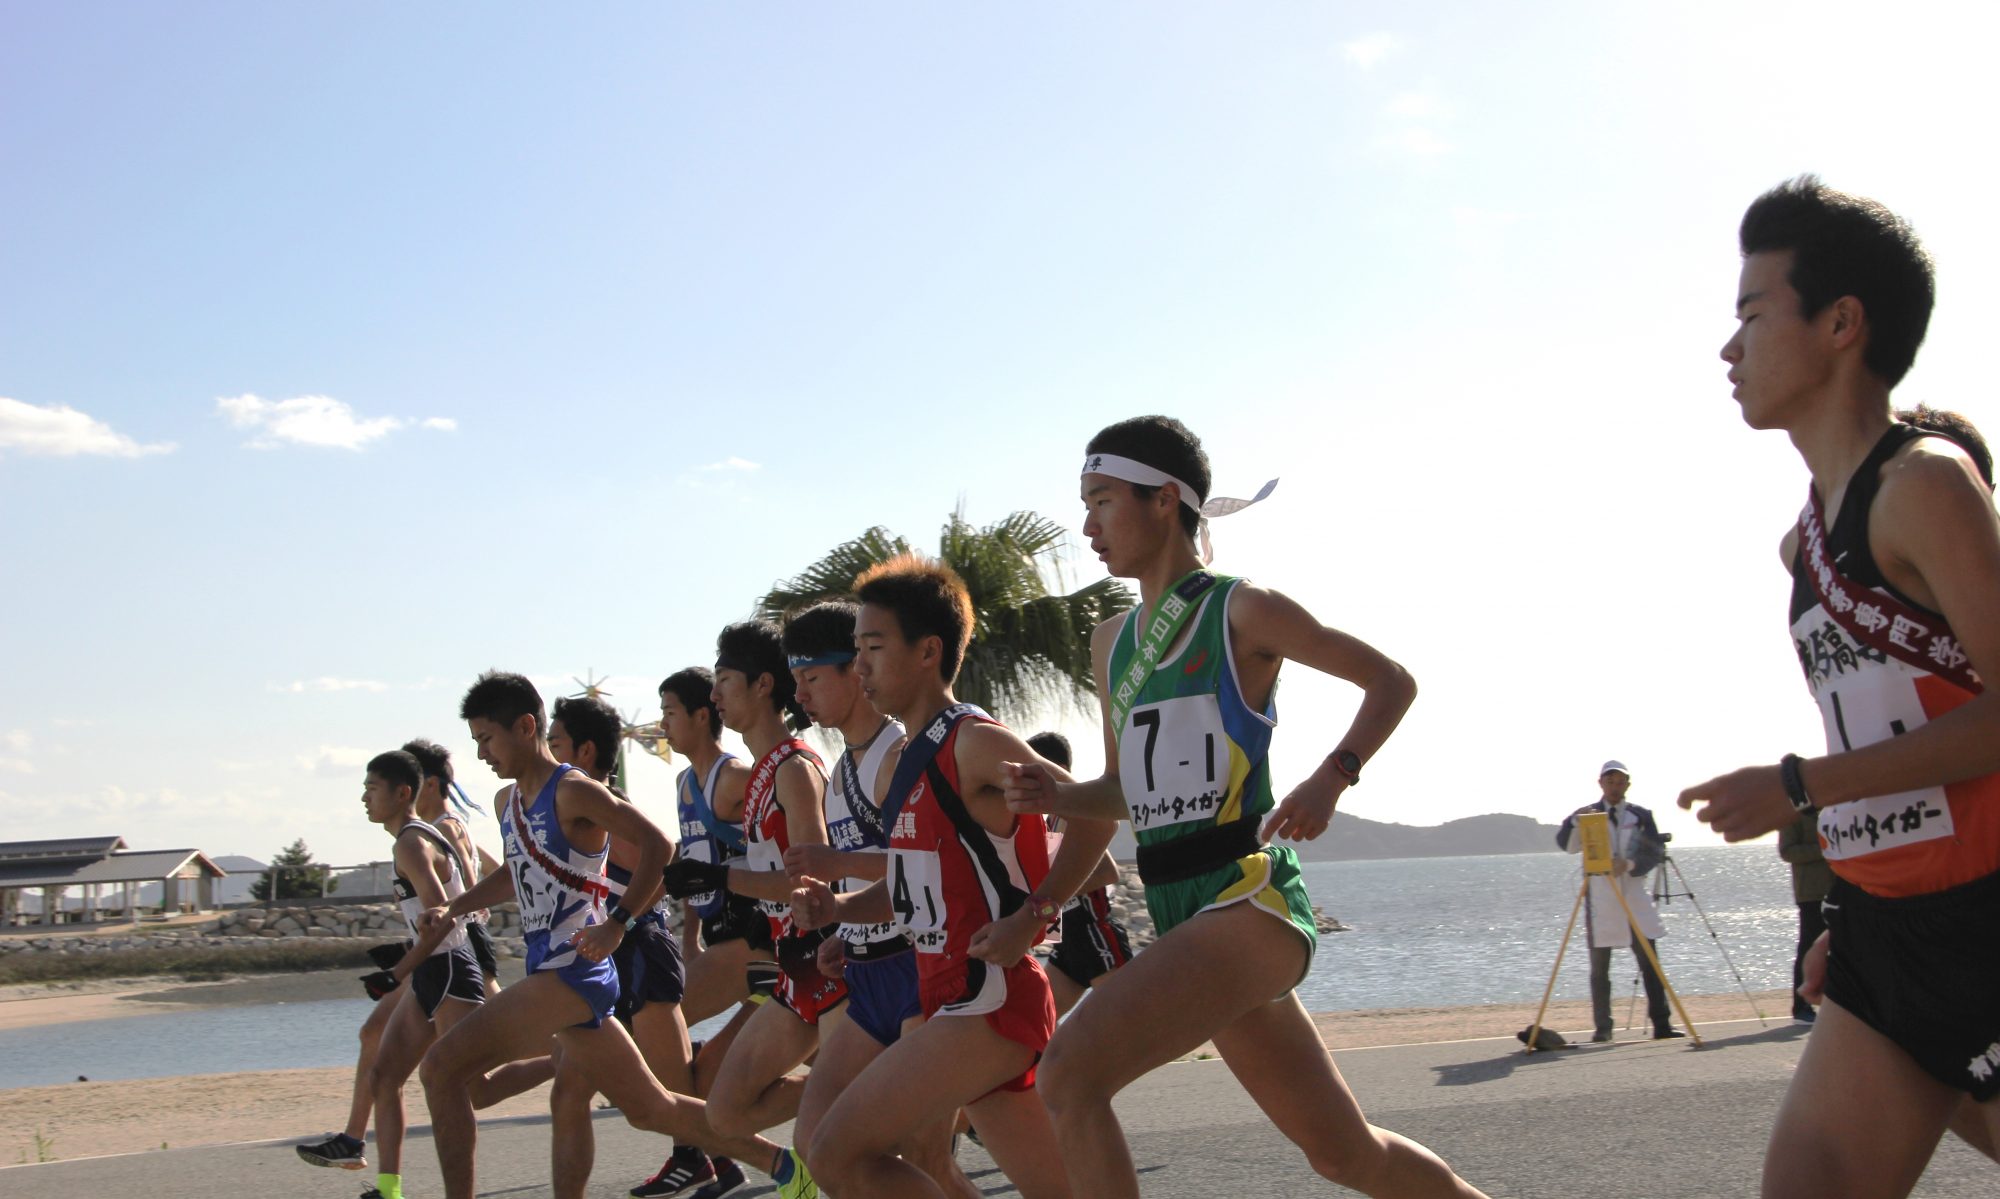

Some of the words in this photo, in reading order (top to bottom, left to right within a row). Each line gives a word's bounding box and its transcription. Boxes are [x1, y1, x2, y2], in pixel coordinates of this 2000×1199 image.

[1132, 789, 1224, 827] スクールタイガー
[1822, 800, 1942, 854] スクールタイガー
